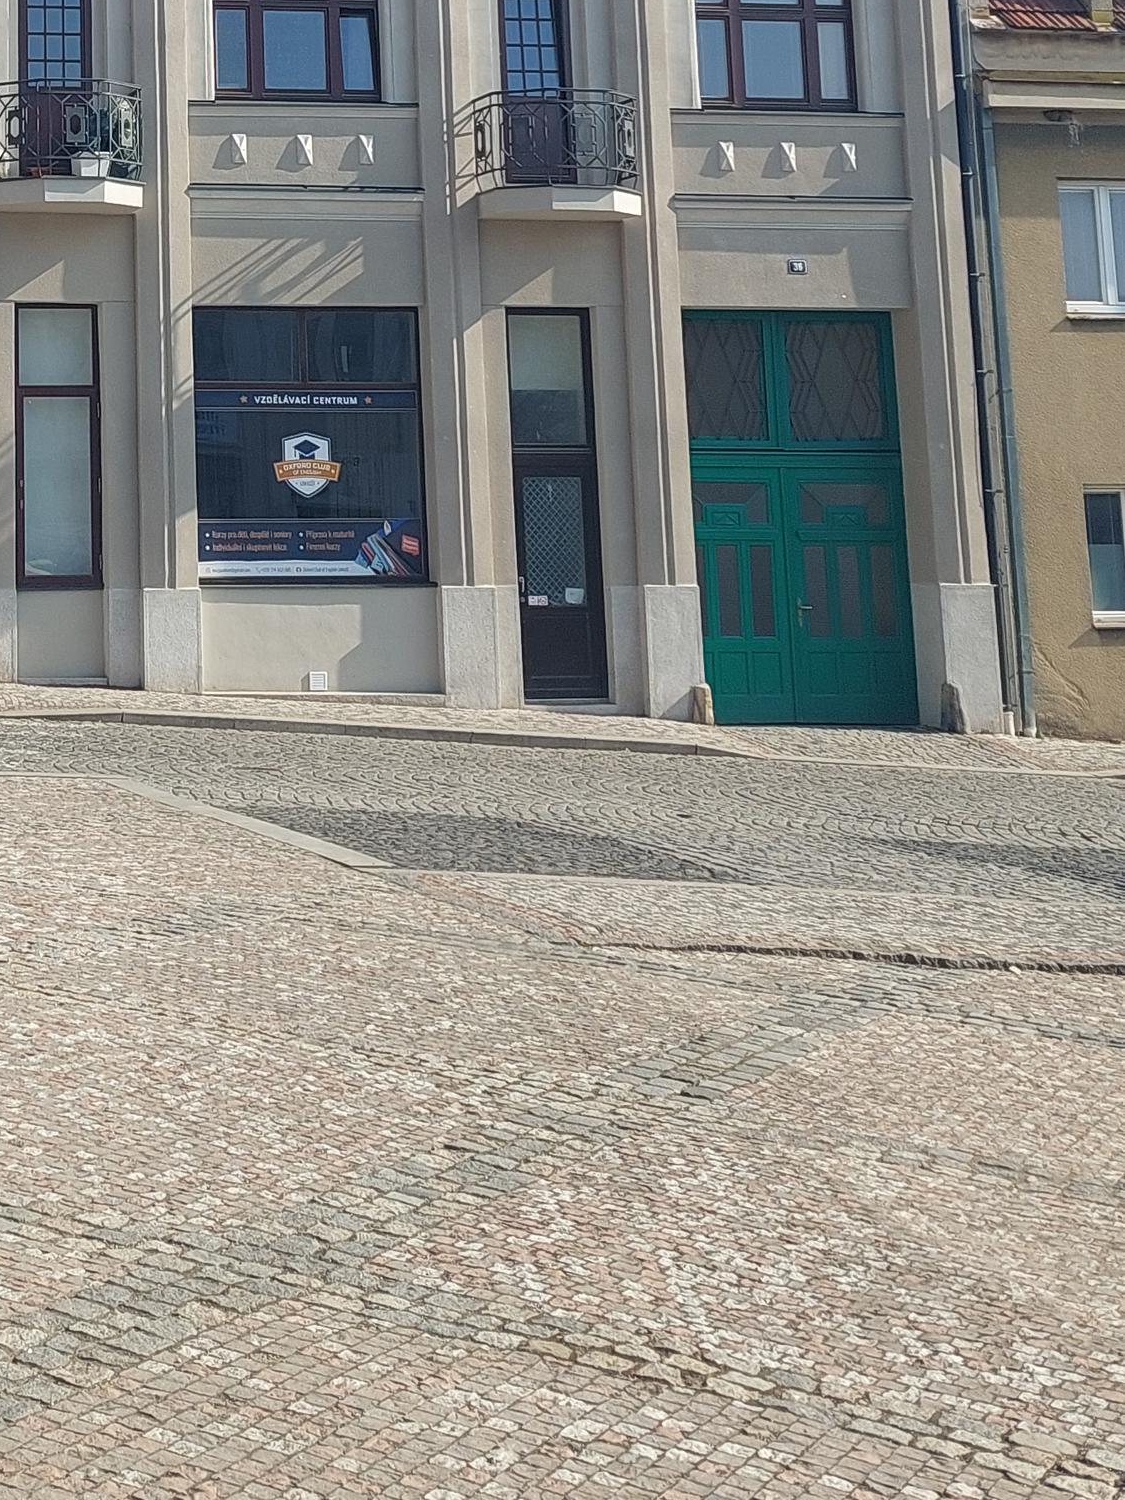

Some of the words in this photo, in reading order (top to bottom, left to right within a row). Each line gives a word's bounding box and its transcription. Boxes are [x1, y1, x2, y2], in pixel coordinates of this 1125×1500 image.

[254, 393, 311, 405] VZDĚLÁVACÍ
[313, 395, 358, 405] CENTRUM
[283, 462, 312, 472] OXFORD
[312, 462, 331, 471] CLUB
